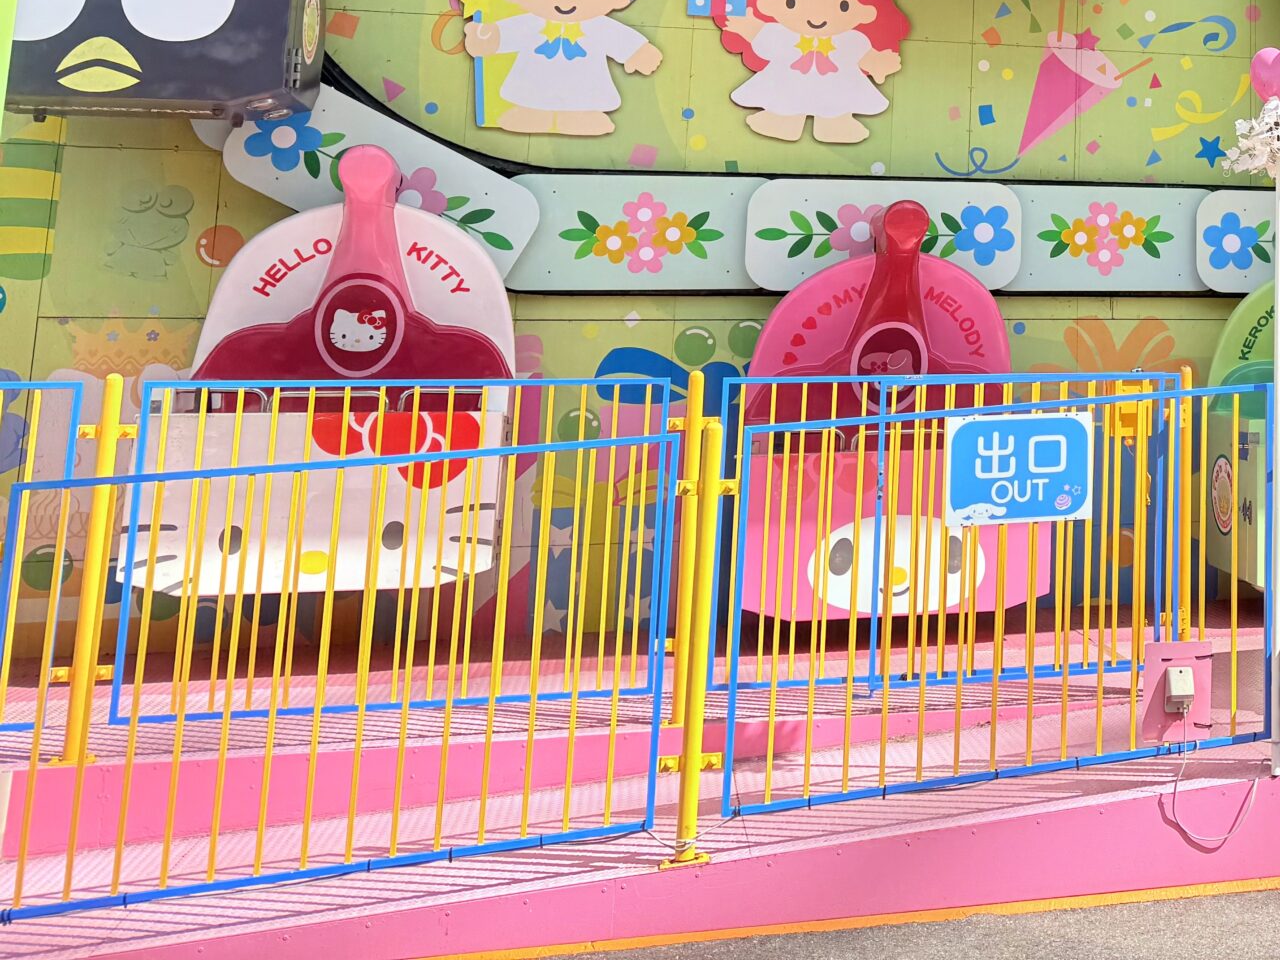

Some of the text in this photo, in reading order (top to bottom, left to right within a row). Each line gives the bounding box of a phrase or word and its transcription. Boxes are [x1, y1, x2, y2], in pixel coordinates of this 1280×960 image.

[252, 238, 471, 297] HELLO KITTY
[832, 283, 985, 358] MY MELODY
[975, 431, 1067, 479] 出口
[991, 478, 1050, 504] OUT
